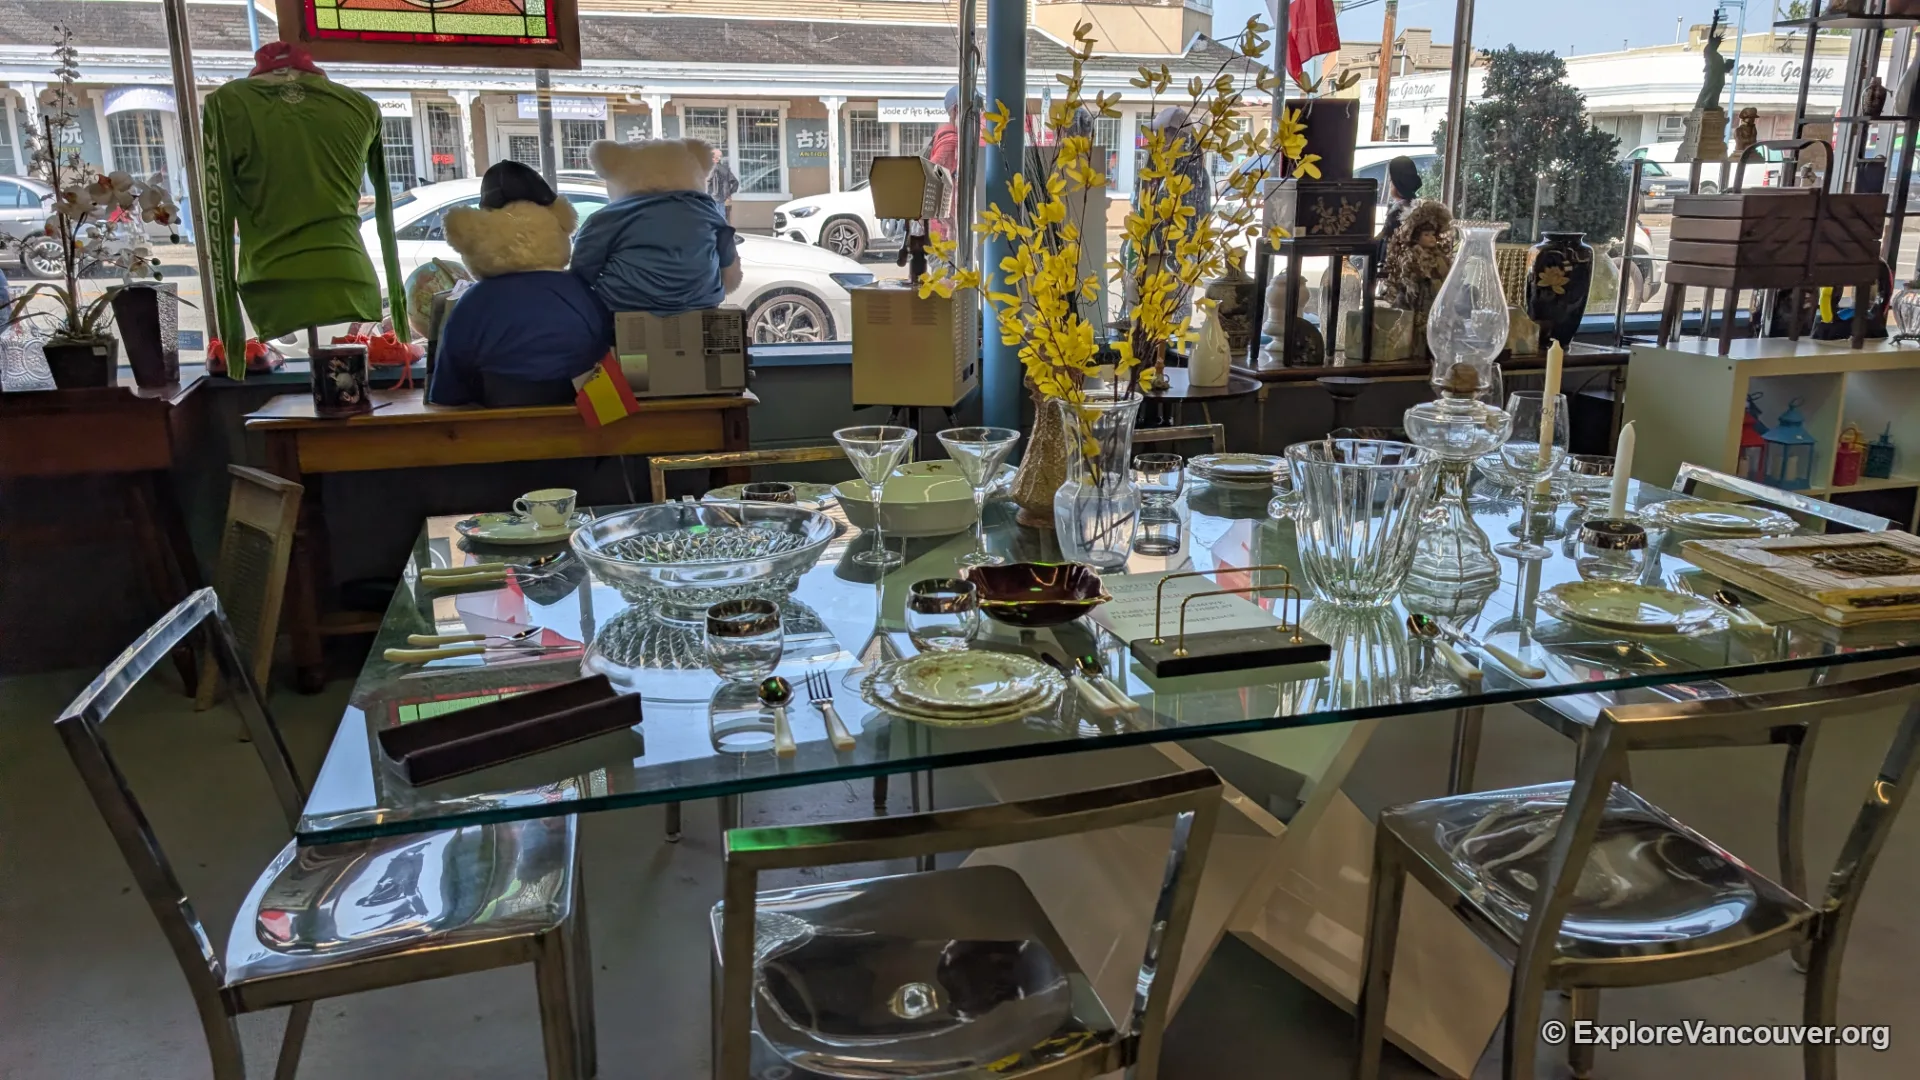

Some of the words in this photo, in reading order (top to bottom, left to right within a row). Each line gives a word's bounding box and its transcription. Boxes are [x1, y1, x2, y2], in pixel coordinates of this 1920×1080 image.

[1730, 59, 1776, 77] arine
[1781, 60, 1834, 84] Gaage
[1400, 82, 1436, 99] Garage
[378, 100, 407, 112] uction
[882, 107, 901, 115] Jade
[204, 132, 225, 294] VANCOUVER
